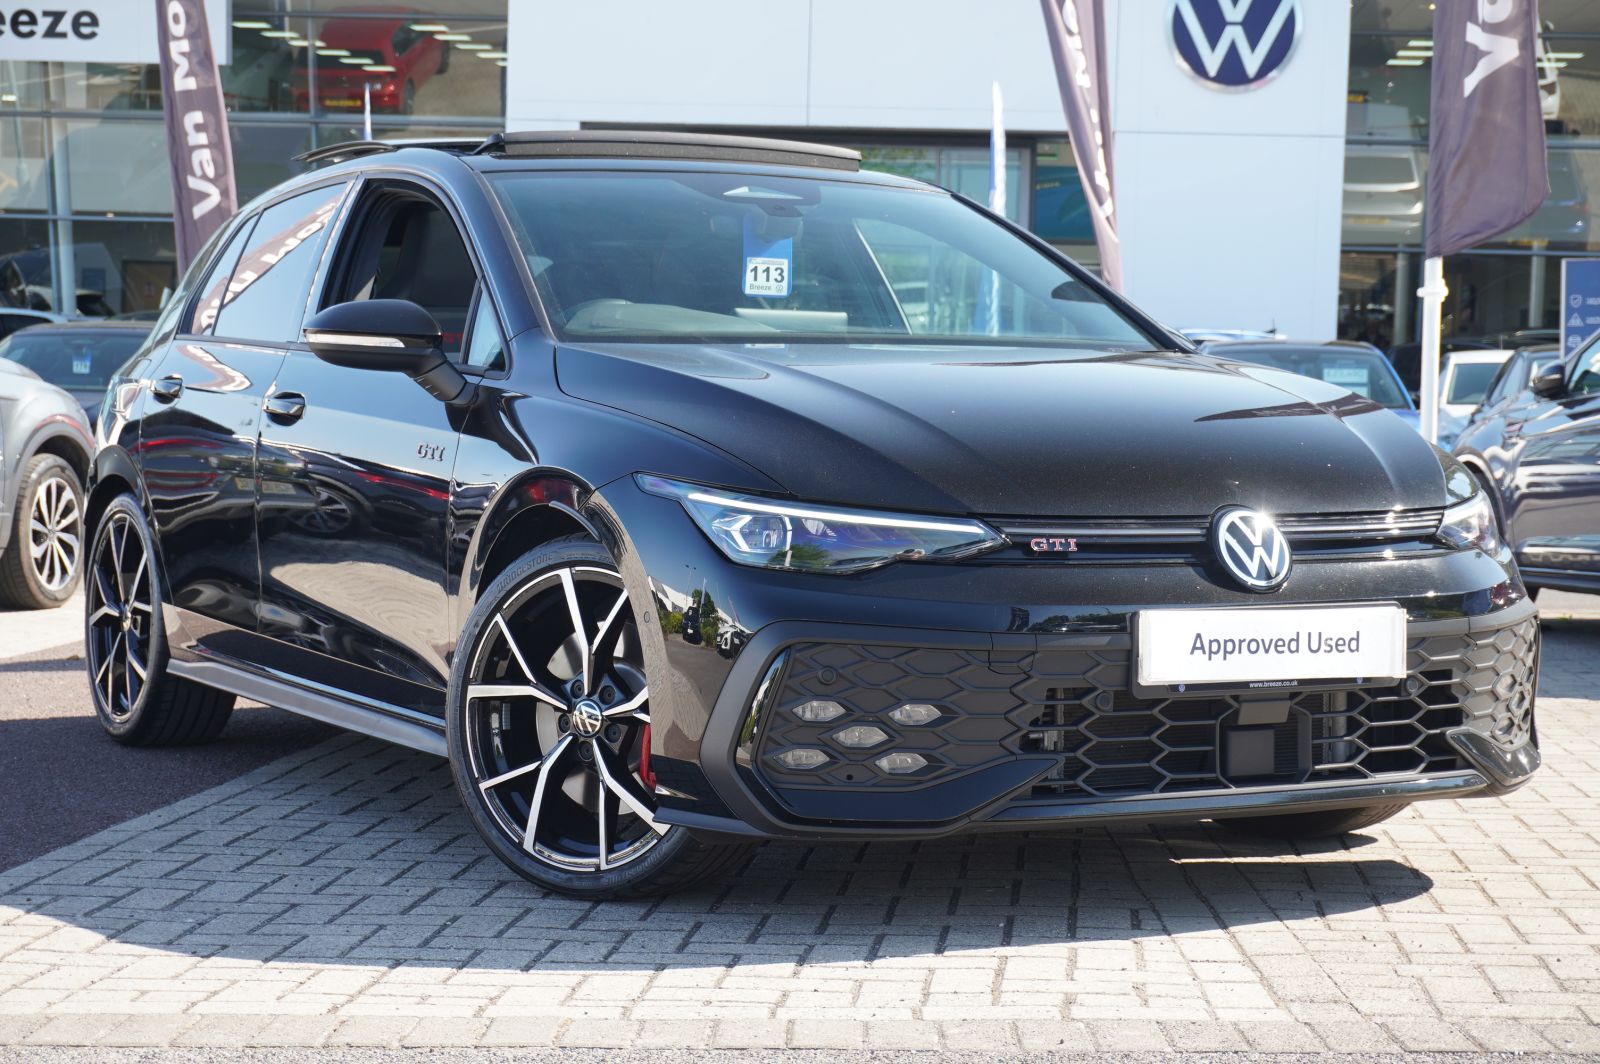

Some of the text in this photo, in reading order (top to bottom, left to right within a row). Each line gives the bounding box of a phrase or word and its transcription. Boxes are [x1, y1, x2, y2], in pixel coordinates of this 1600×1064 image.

[0, 9, 99, 40] eze
[183, 110, 221, 220] Van
[750, 265, 785, 283] 113
[417, 443, 446, 461] GTI
[1030, 538, 1078, 552] GTI
[1219, 511, 1290, 586] VW
[1190, 631, 1360, 661] Approved Used
[1248, 679, 1298, 688] www.breeze.co.uk
